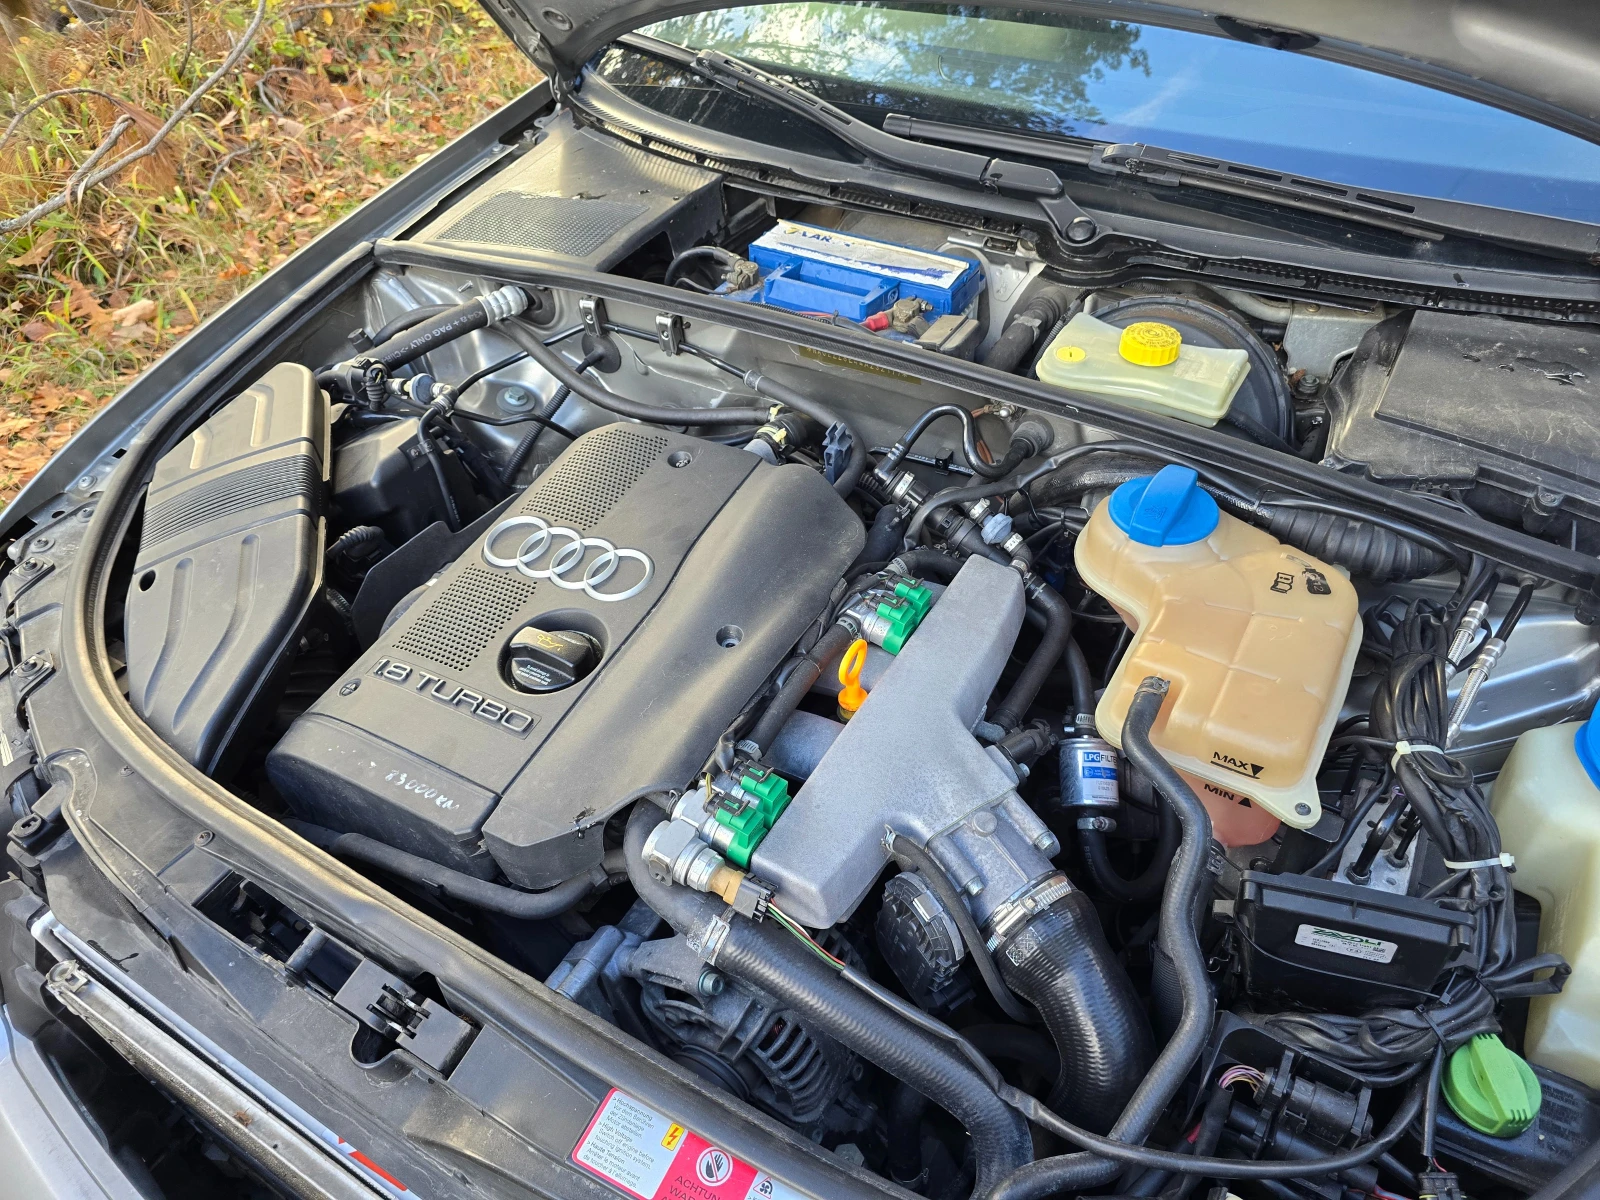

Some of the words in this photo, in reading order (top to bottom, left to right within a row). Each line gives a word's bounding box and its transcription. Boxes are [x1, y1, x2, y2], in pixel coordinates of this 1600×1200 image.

[432, 324, 453, 337] PAG
[410, 333, 432, 350] ONLY
[416, 670, 535, 734] TURBO
[1084, 753, 1100, 761] LPG
[1212, 751, 1250, 771] MAX
[1204, 783, 1236, 801] MIN
[601, 1122, 615, 1133] High
